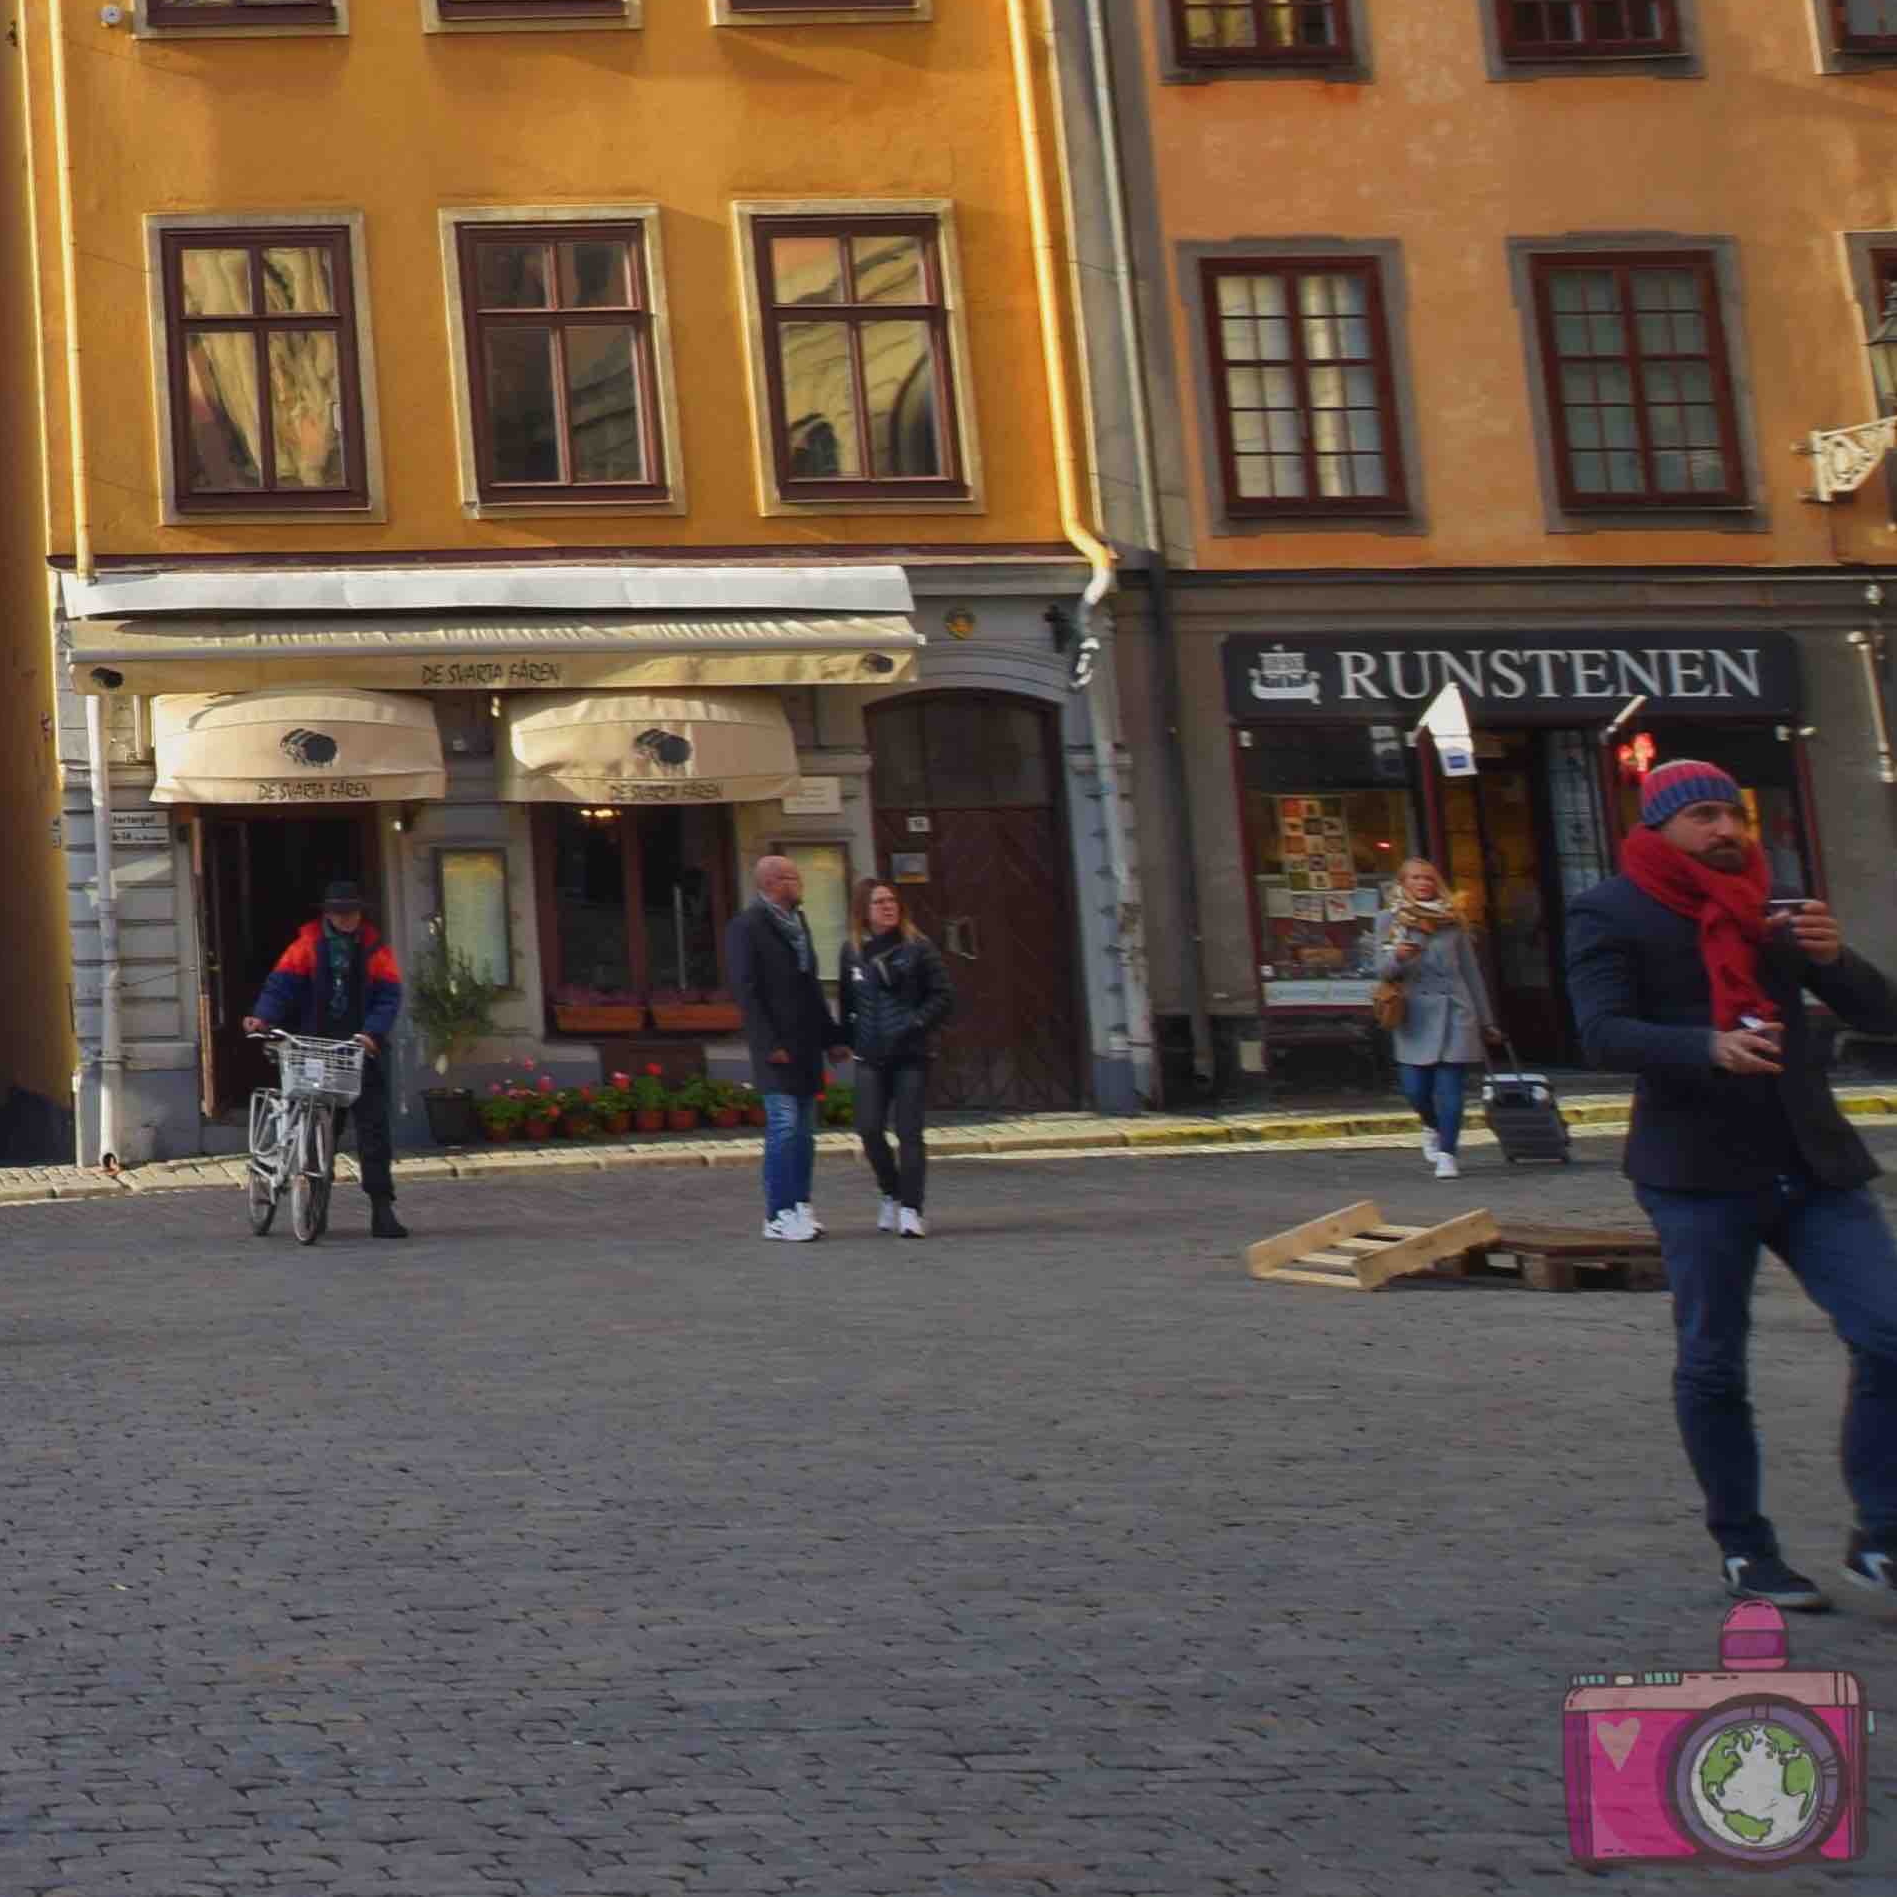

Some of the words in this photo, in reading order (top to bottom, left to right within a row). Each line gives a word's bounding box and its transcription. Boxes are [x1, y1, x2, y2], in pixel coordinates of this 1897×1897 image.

[421, 663, 444, 684] DE
[445, 662, 503, 684] SVARTA
[509, 656, 561, 683] FÅREN
[1336, 649, 1761, 700] RUNSTENEN
[258, 783, 277, 800] DE
[112, 814, 155, 828] tortorget
